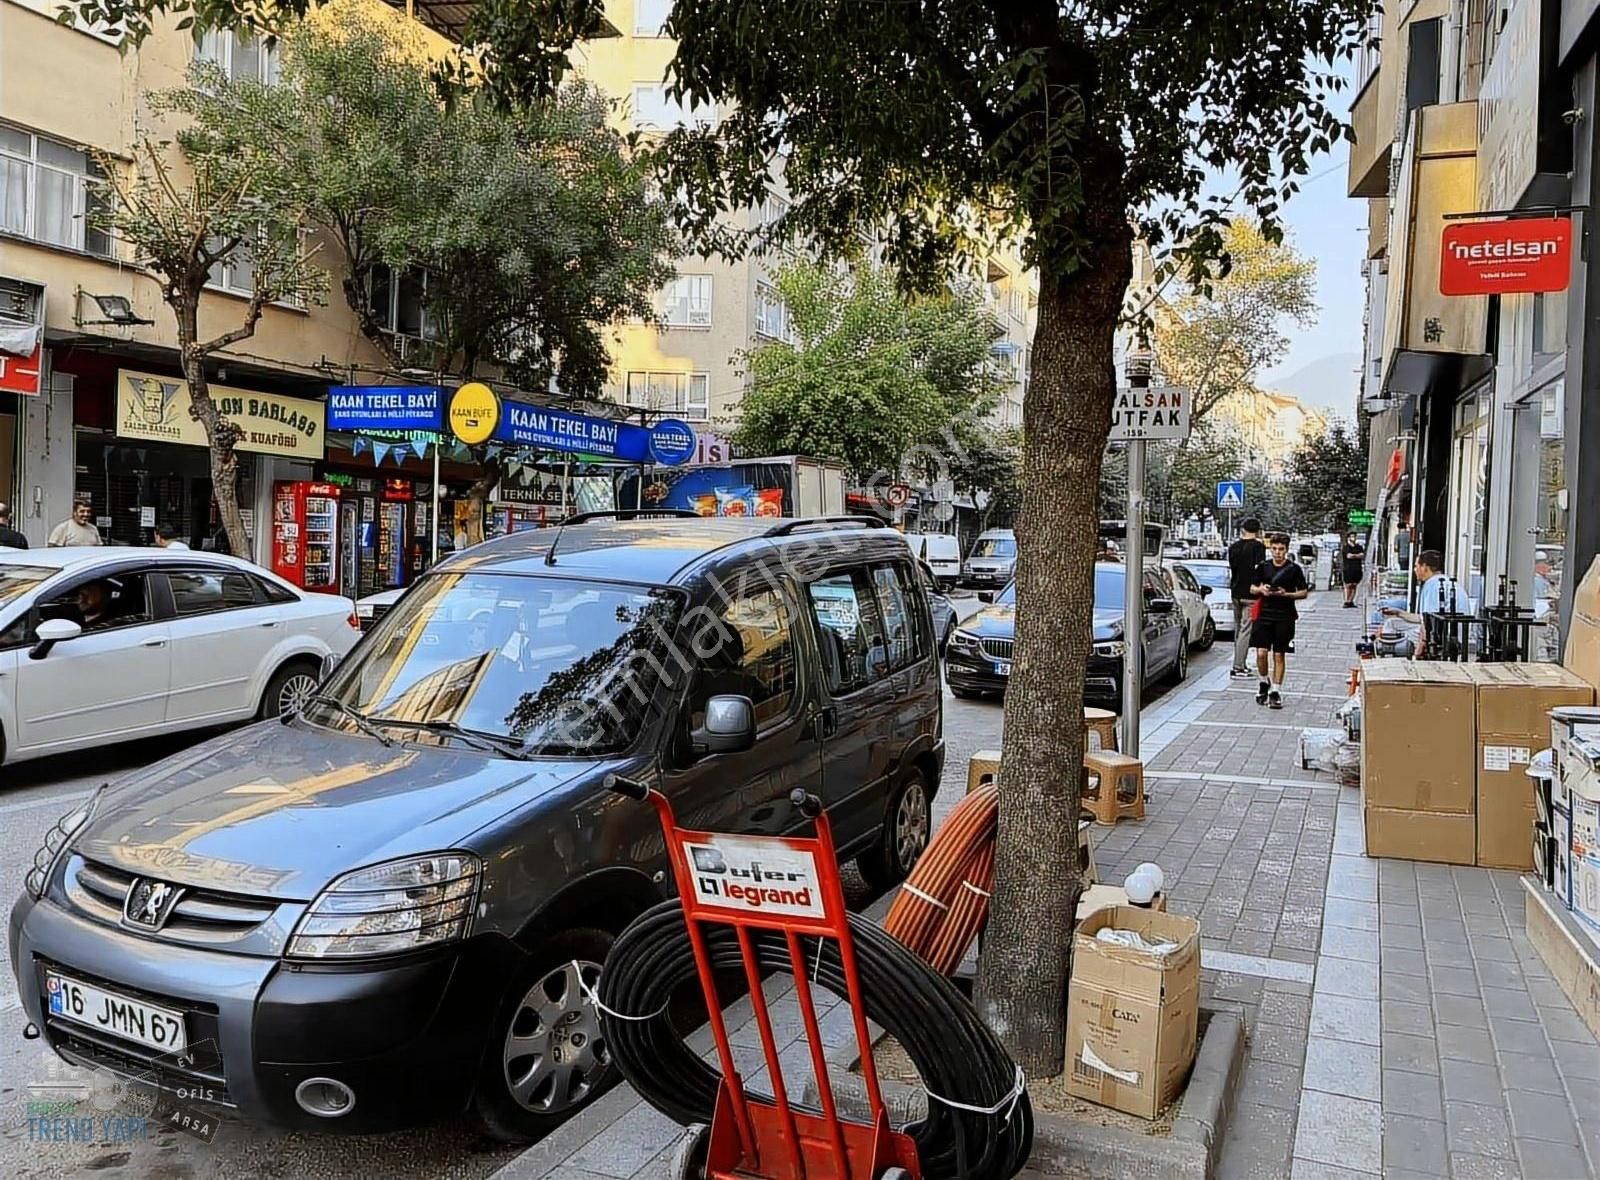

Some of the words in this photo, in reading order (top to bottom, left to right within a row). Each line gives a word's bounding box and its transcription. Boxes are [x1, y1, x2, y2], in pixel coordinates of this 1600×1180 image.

[1455, 237, 1558, 259] netelsan
[210, 397, 243, 415] LON
[331, 394, 364, 409] KAAN
[366, 394, 405, 408] TEKEL
[408, 391, 437, 408] BAYİ
[1118, 393, 1181, 408] ALSAN
[452, 408, 471, 417] KAAN
[1112, 409, 1180, 426] UTFAK
[511, 408, 547, 432] KAAN
[550, 416, 589, 438] TEKEL
[592, 424, 618, 443] BAYİ
[250, 431, 297, 448] KUAFÖRÜ
[503, 487, 544, 502] TEKNİK
[722, 879, 812, 907] legrand
[62, 982, 85, 1016] 16
[97, 998, 146, 1038] JMN
[151, 1013, 180, 1047] 67
